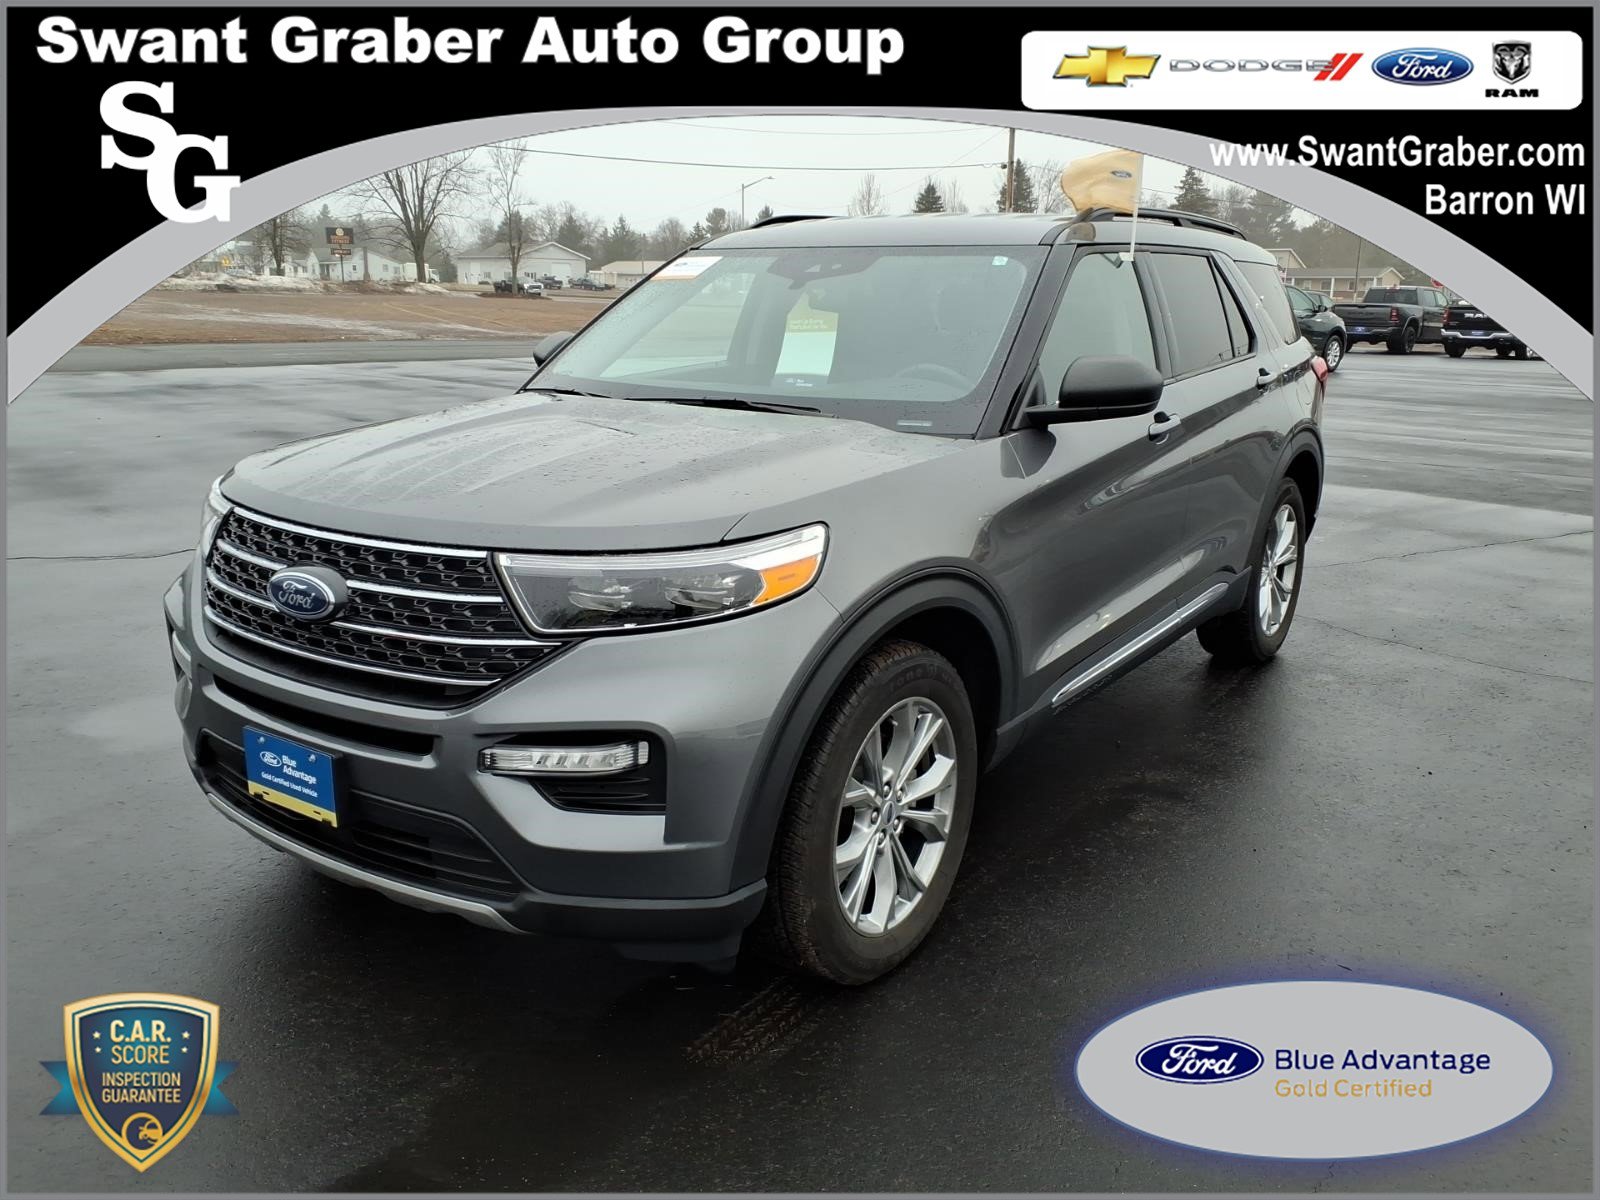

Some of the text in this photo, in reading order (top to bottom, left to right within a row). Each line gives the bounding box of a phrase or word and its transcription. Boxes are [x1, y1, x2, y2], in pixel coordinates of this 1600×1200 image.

[278, 580, 317, 609] Ford
[282, 754, 297, 768] Blue
[261, 771, 272, 781] Gold
[283, 764, 317, 785] Advantage
